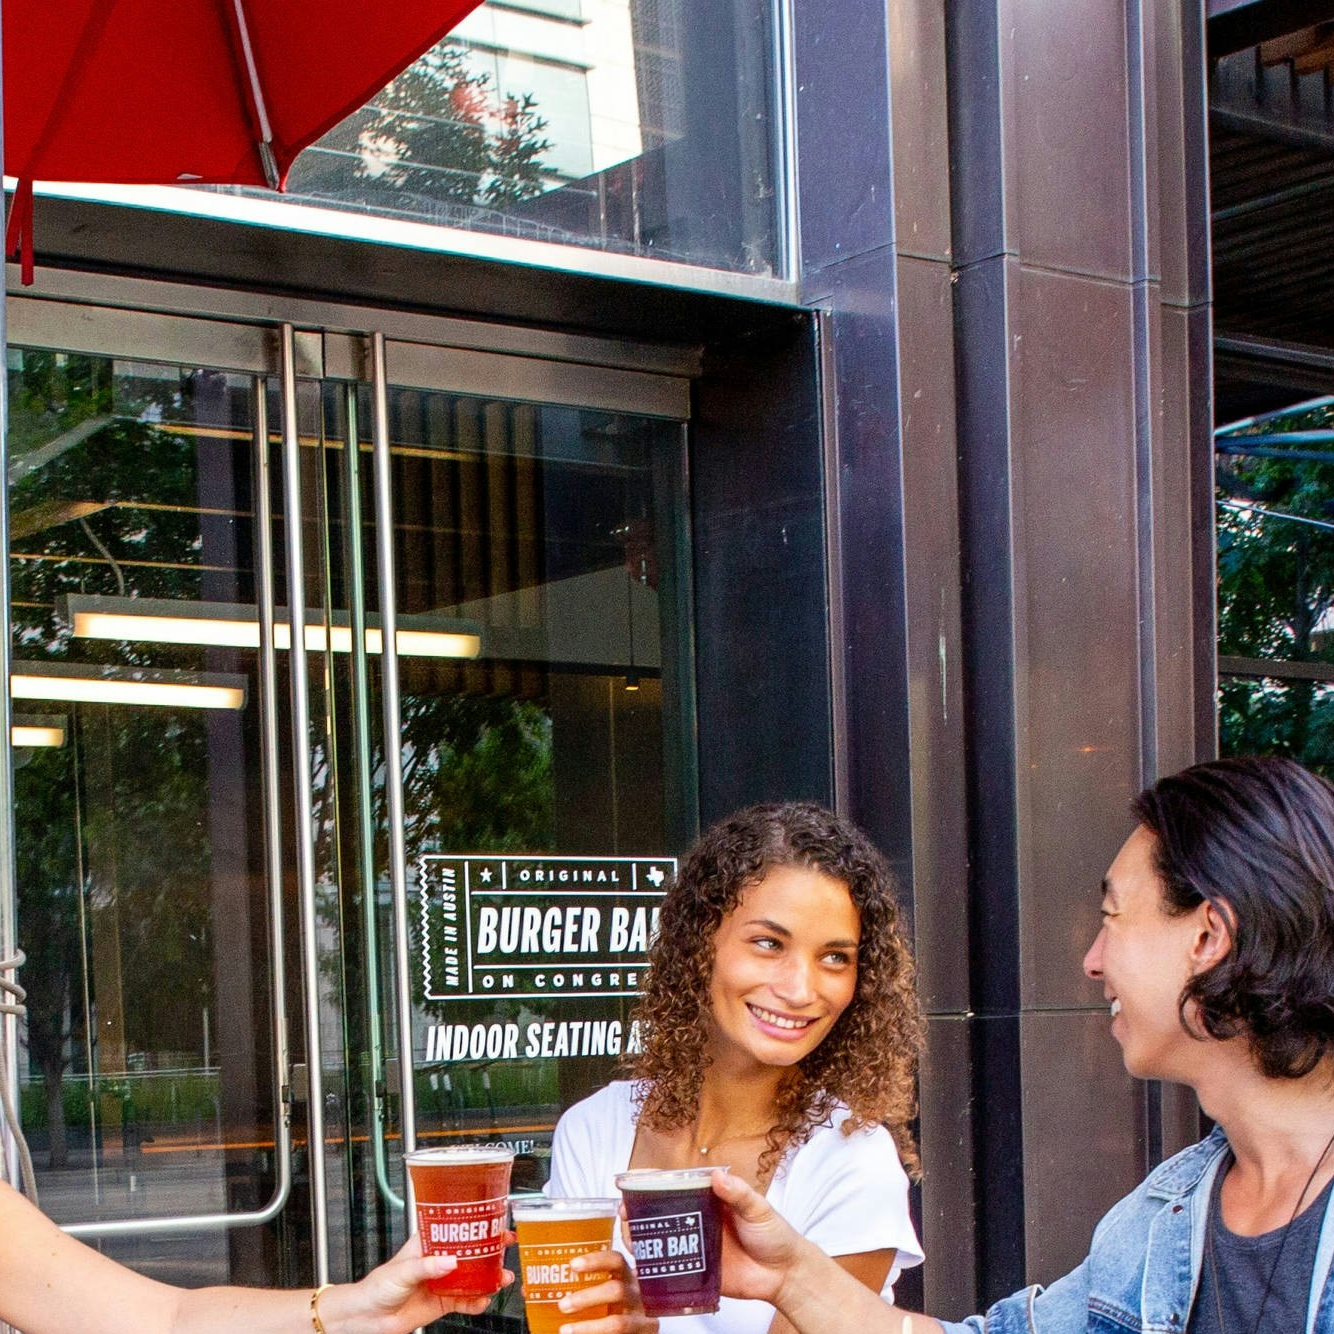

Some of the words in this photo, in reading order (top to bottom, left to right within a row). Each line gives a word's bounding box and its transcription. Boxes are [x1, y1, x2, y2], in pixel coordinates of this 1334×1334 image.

[519, 869, 620, 882] ORIGINAL
[441, 868, 457, 922] AUSTIN
[443, 926, 458, 942] IN
[477, 906, 601, 954] BURGER
[444, 947, 459, 986] MADE
[482, 974, 515, 988] ON
[535, 972, 637, 987] CONGRE
[425, 1023, 520, 1062] INDOOR
[525, 1020, 622, 1058] SEATING
[430, 1220, 489, 1242] BURGER
[667, 1233, 700, 1257] BAR
